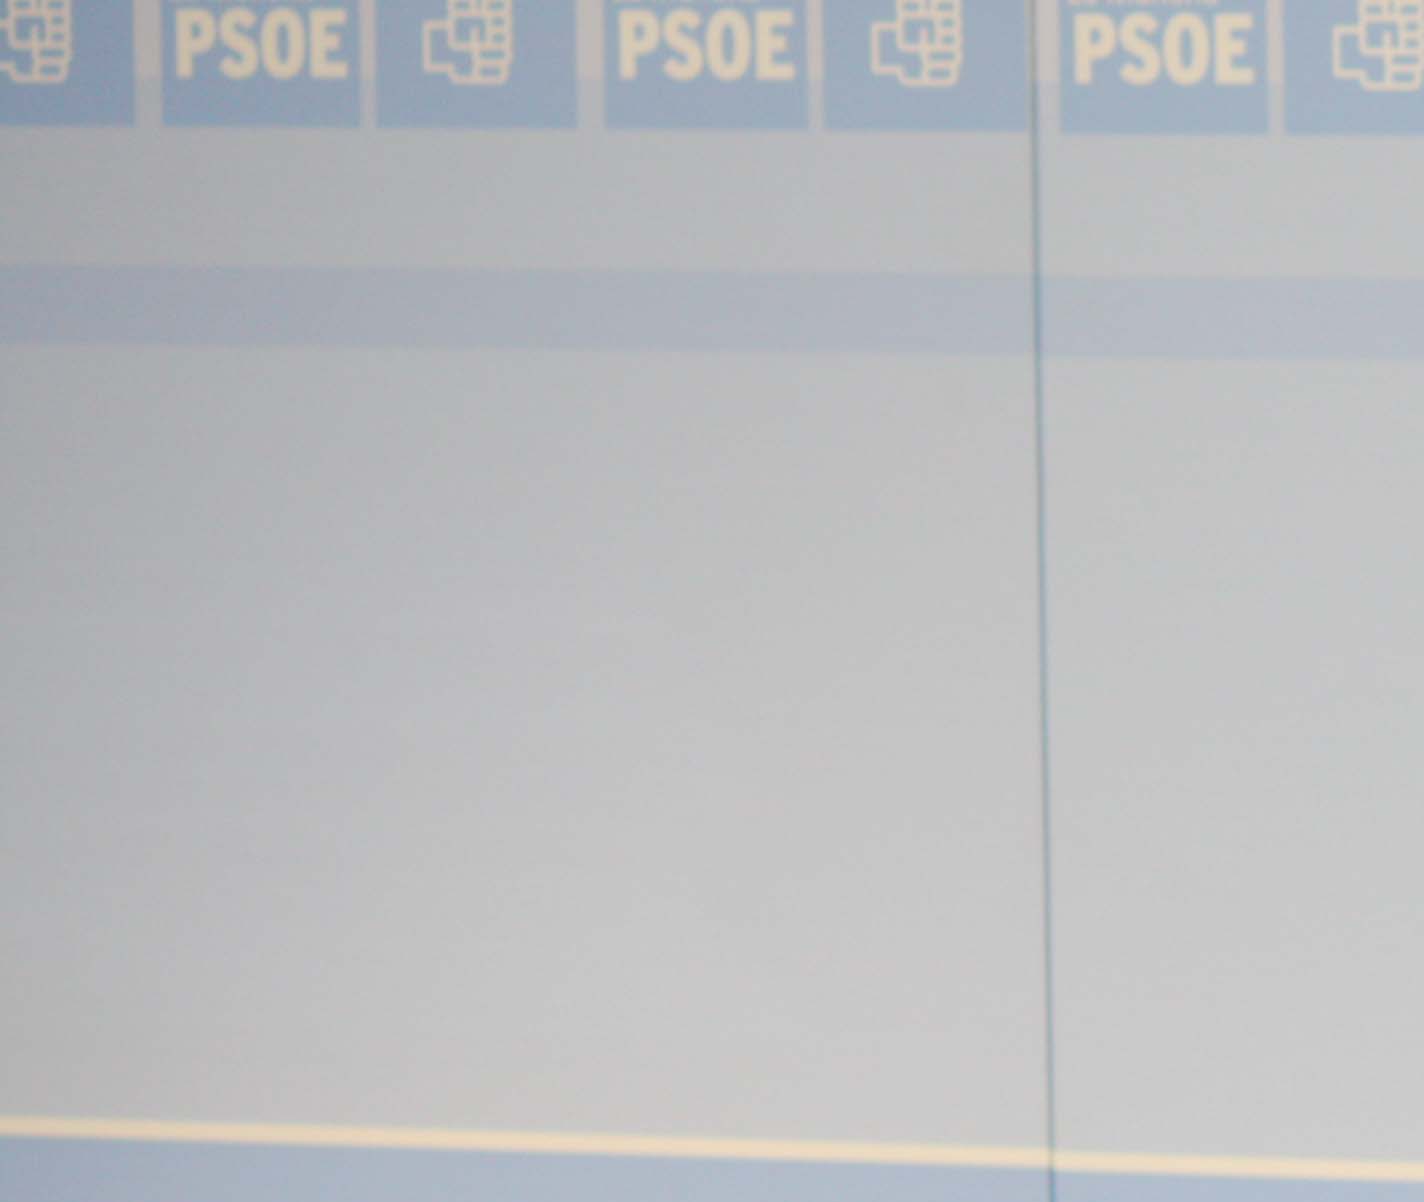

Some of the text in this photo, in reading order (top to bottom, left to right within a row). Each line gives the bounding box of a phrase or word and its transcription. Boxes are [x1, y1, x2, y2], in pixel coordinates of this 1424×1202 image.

[177, 9, 348, 79] PSOE
[620, 10, 796, 80] PSOE
[1076, 13, 1256, 85] PSOE
